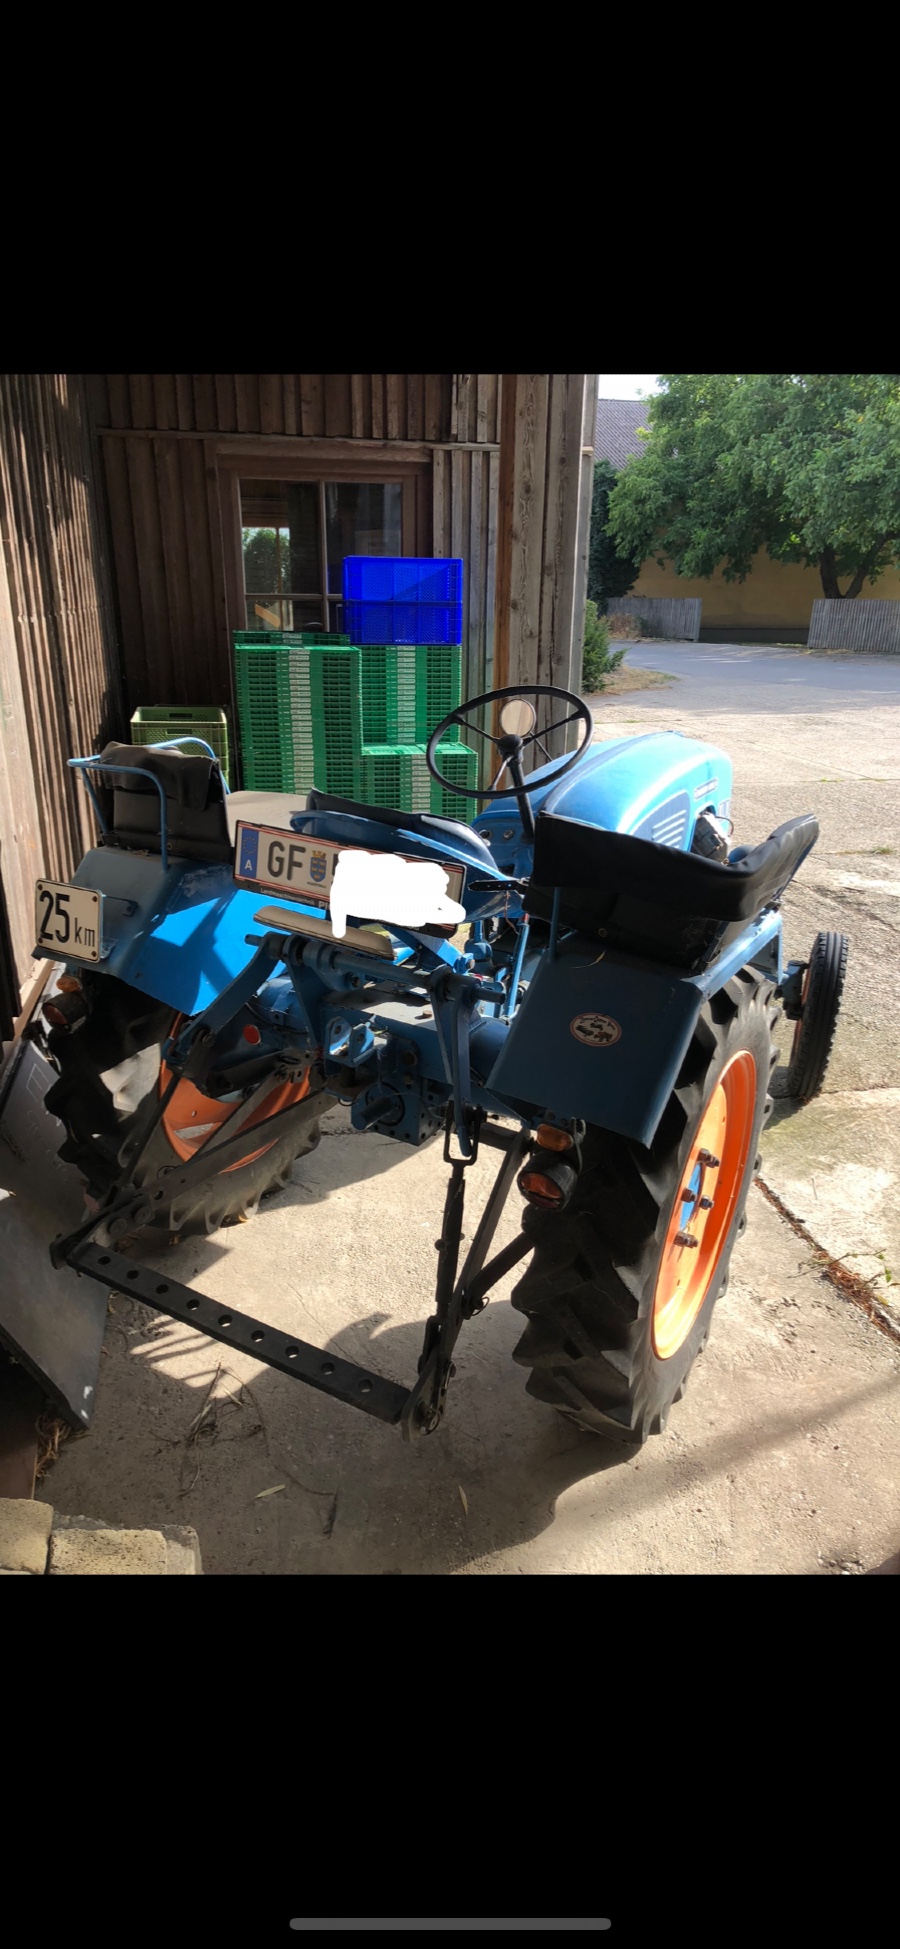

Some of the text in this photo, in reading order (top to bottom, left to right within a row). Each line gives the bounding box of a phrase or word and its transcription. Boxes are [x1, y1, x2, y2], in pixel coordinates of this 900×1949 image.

[244, 860, 253, 871] A
[267, 841, 306, 881] GF
[39, 890, 95, 948] 25 km
